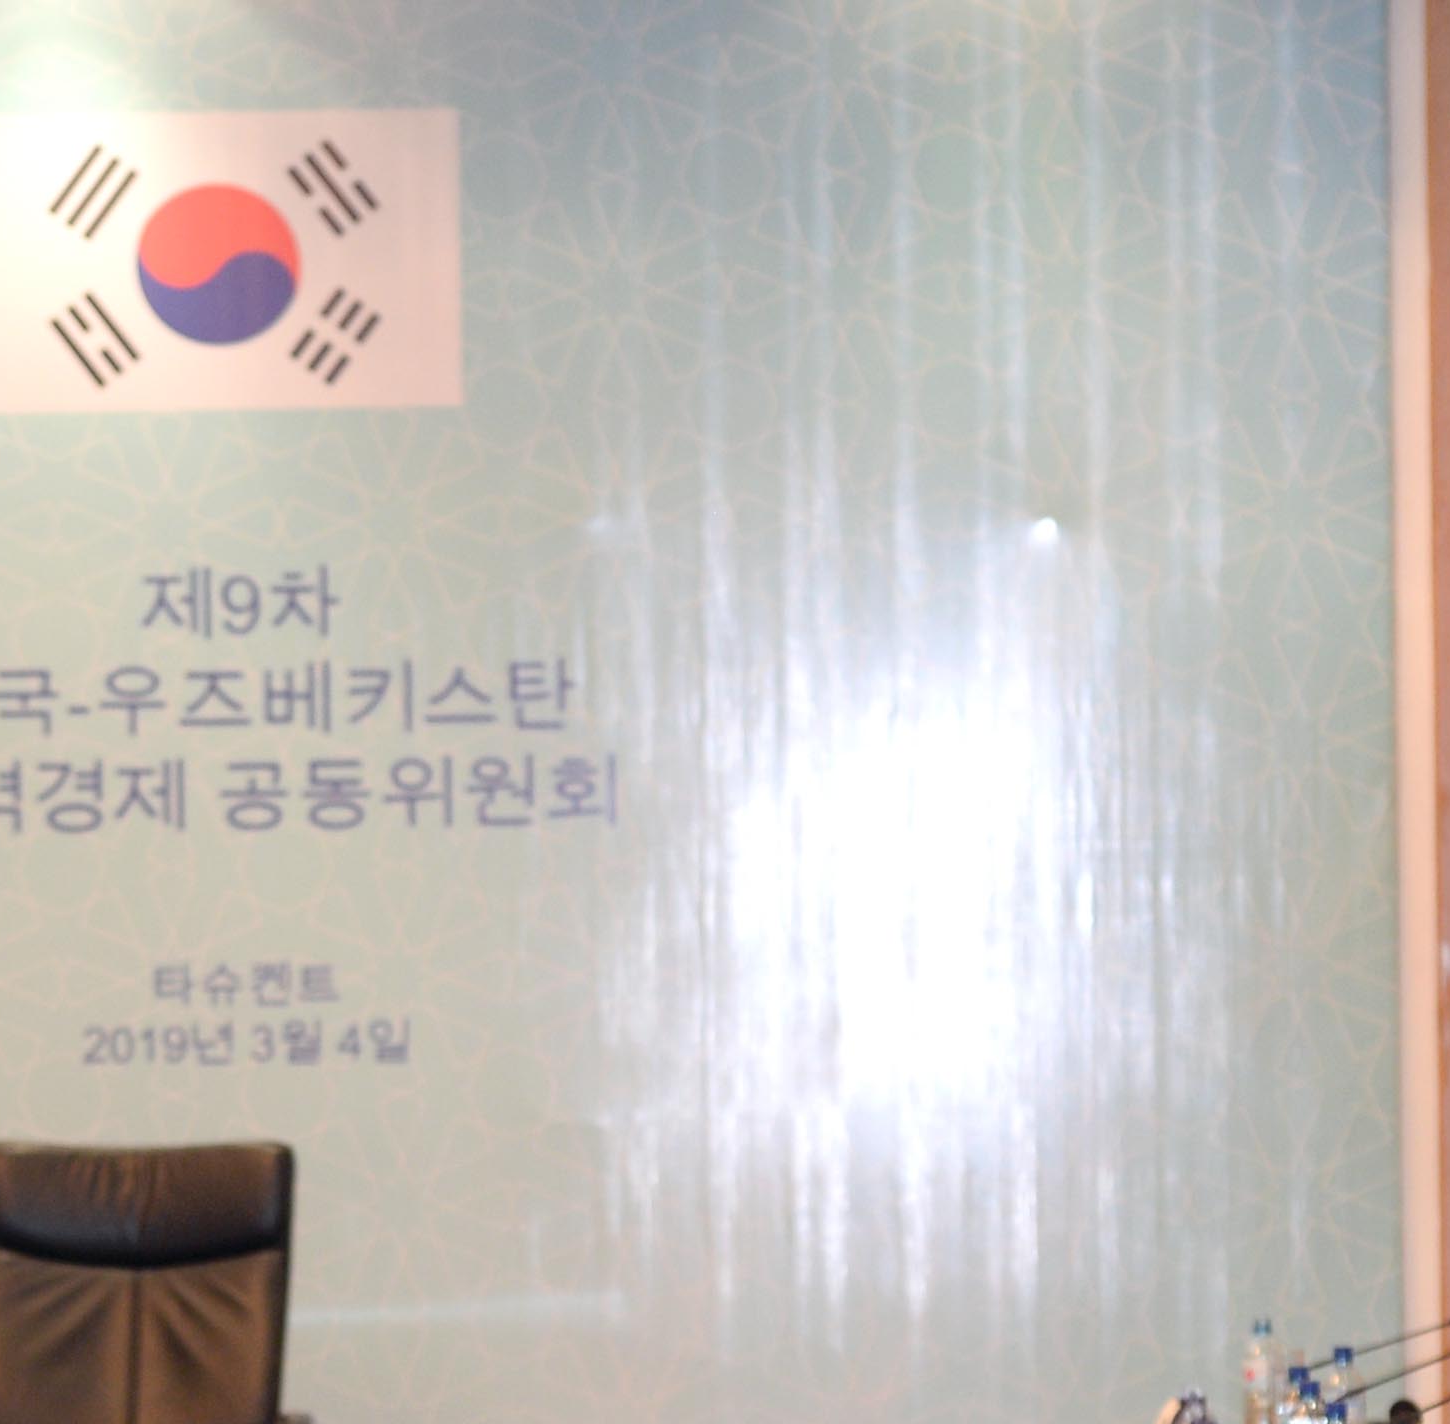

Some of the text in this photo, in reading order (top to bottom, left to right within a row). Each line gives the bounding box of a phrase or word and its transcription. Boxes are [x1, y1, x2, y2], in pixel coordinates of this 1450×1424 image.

[140, 565, 340, 639] 제9차
[218, 752, 620, 832] 공동위원회
[153, 962, 340, 1007] 타슈켄트
[82, 1015, 412, 1066] 2019년 3월 4일
